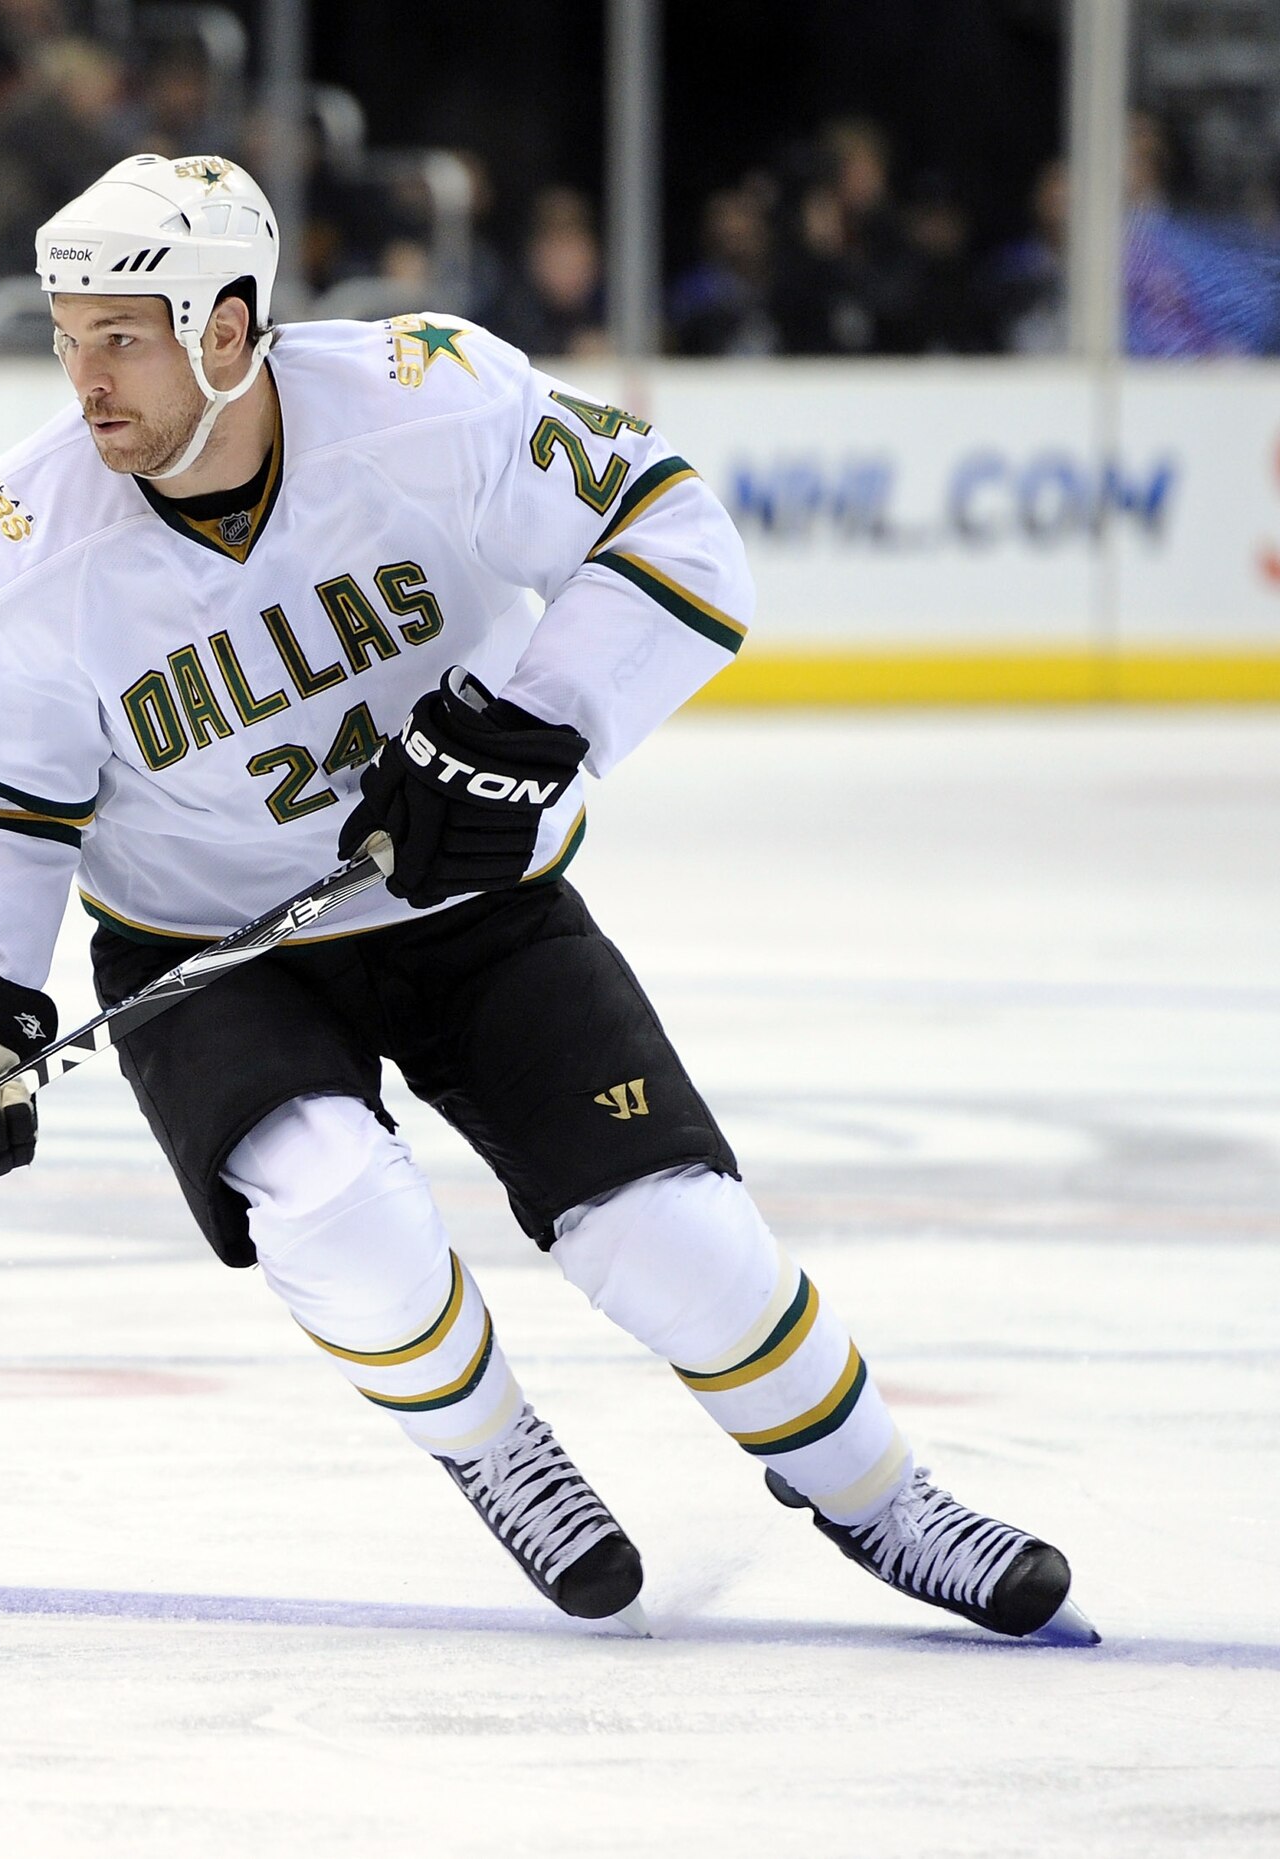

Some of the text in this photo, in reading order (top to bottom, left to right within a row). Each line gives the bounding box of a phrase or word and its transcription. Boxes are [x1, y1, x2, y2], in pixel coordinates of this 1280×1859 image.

[49, 247, 93, 262] Reebok
[384, 320, 396, 379] DALL
[530, 390, 653, 517] 24
[729, 448, 1176, 550] NHL.COM
[121, 560, 444, 772] DALLAS
[246, 701, 389, 825] 24
[401, 712, 559, 804] ASTON
